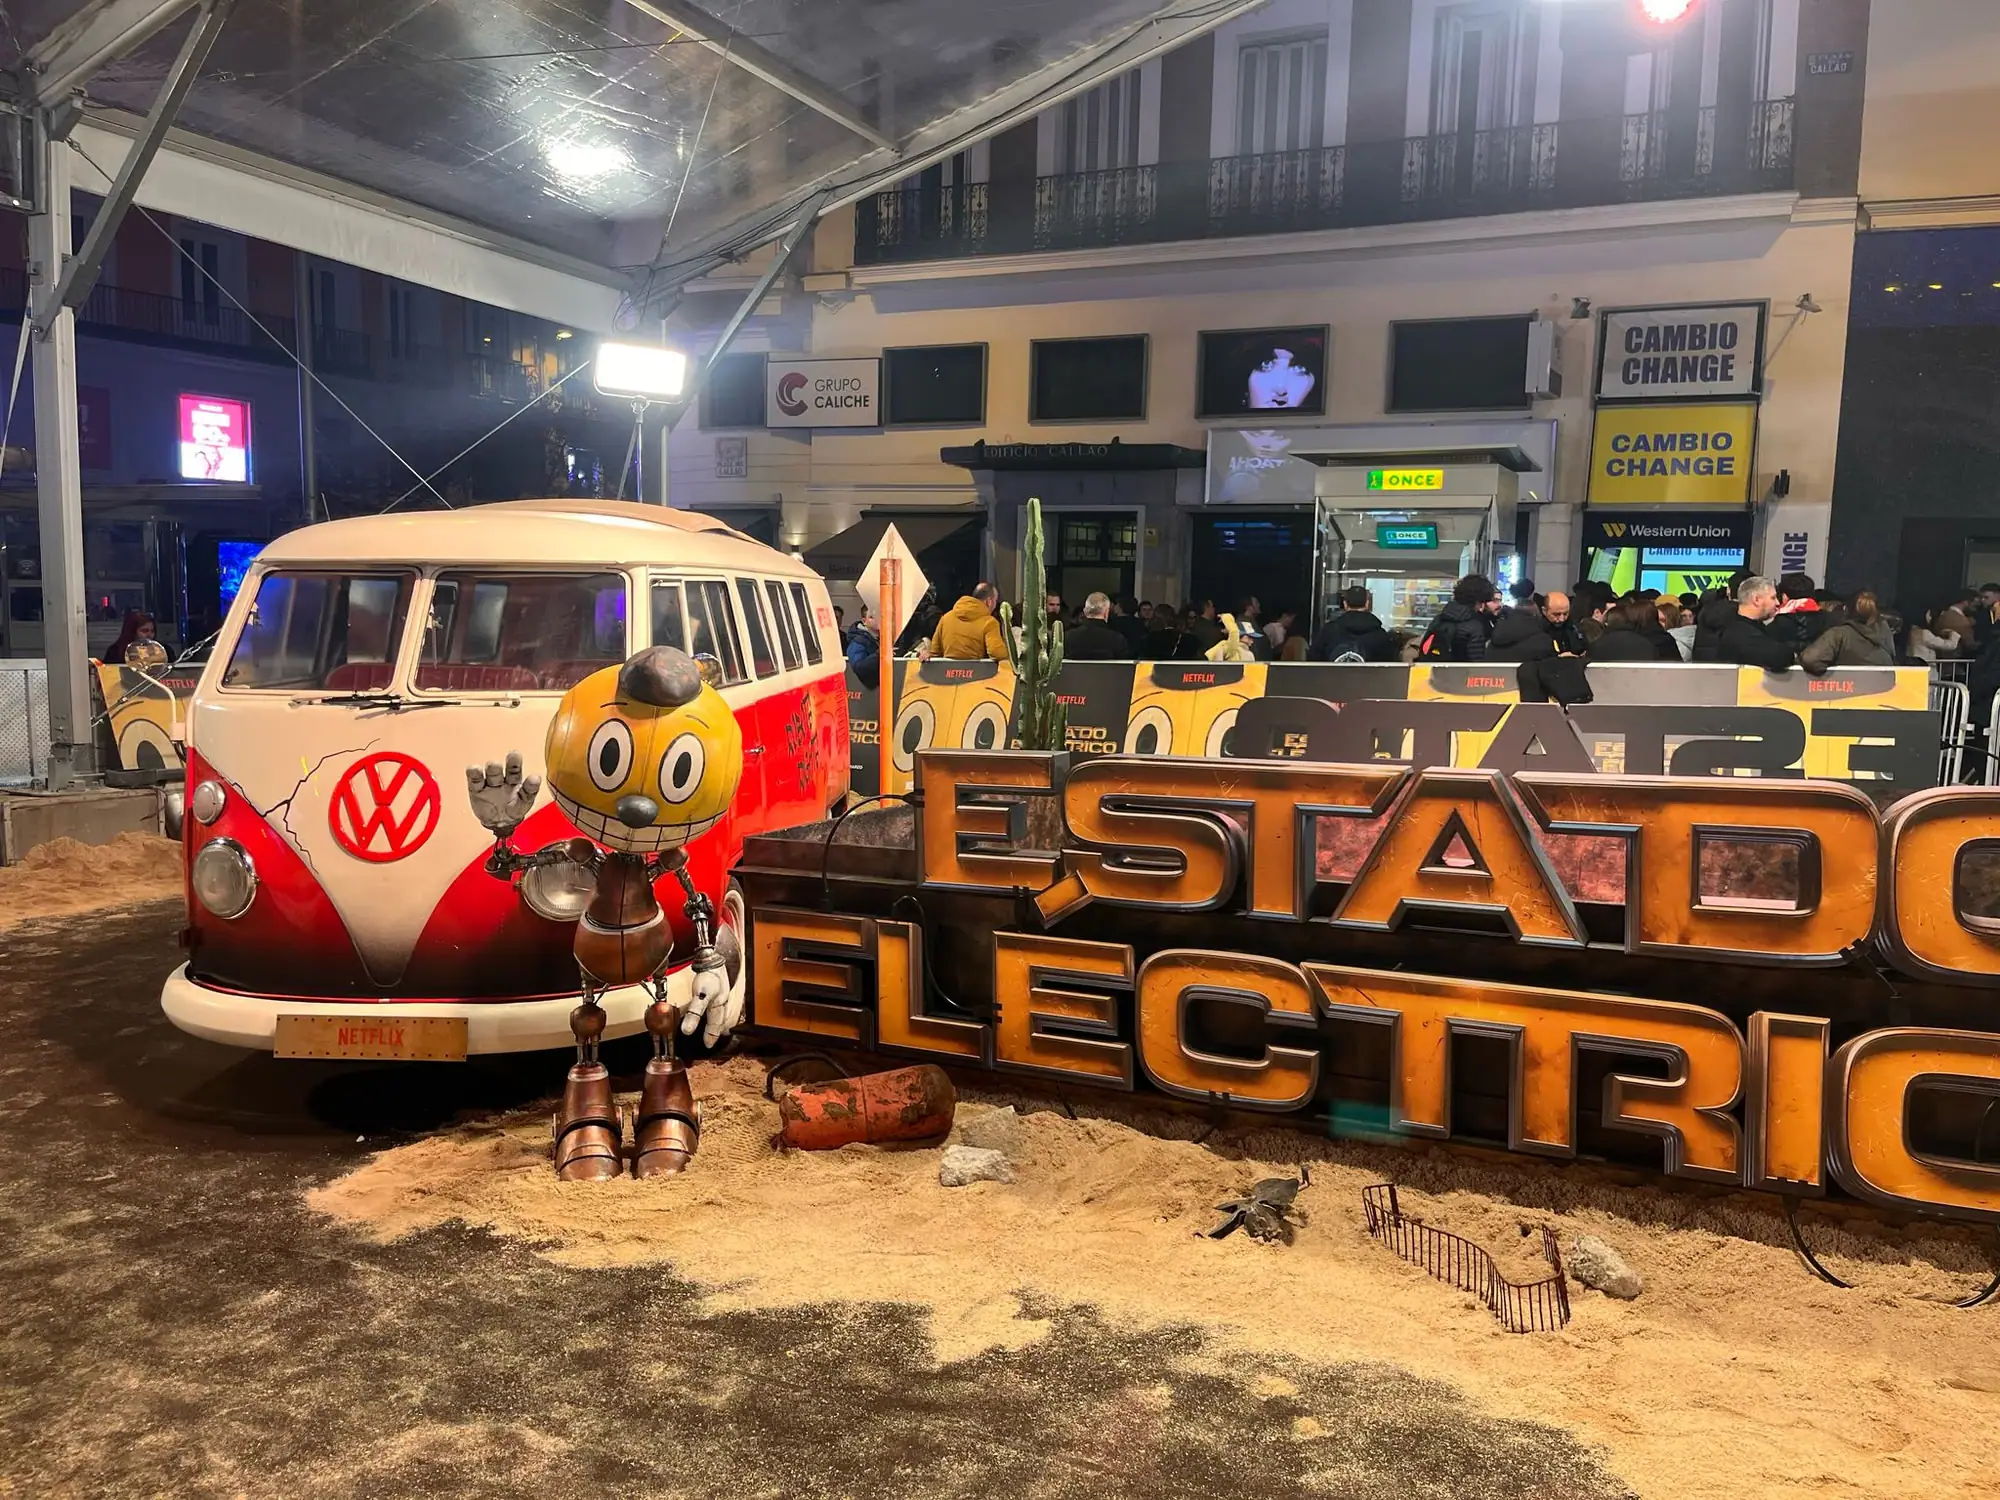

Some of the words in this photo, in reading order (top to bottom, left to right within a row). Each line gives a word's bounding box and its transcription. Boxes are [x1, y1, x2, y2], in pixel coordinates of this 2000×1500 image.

[1624, 322, 1739, 354] CAMBIO
[1621, 354, 1736, 385] CHANGE
[814, 378, 862, 392] GRUPO
[814, 395, 870, 409] CALICHE
[1611, 432, 1734, 453] CAMBIO
[984, 446, 1038, 458] EDIFICIO
[1048, 445, 1109, 457] CALLAO
[1606, 456, 1736, 476] CHANGE
[1388, 475, 1436, 486] ONCE
[1630, 524, 1687, 537] Western
[1689, 524, 1731, 537] Union
[945, 669, 974, 678] NETFLIX
[1183, 673, 1216, 684] NETFLIX
[1466, 677, 1505, 688] NETFLIX
[1808, 680, 1854, 693] NETFLIX
[1056, 695, 1087, 705] NETFLIX
[337, 1027, 406, 1047] NETFLIX
